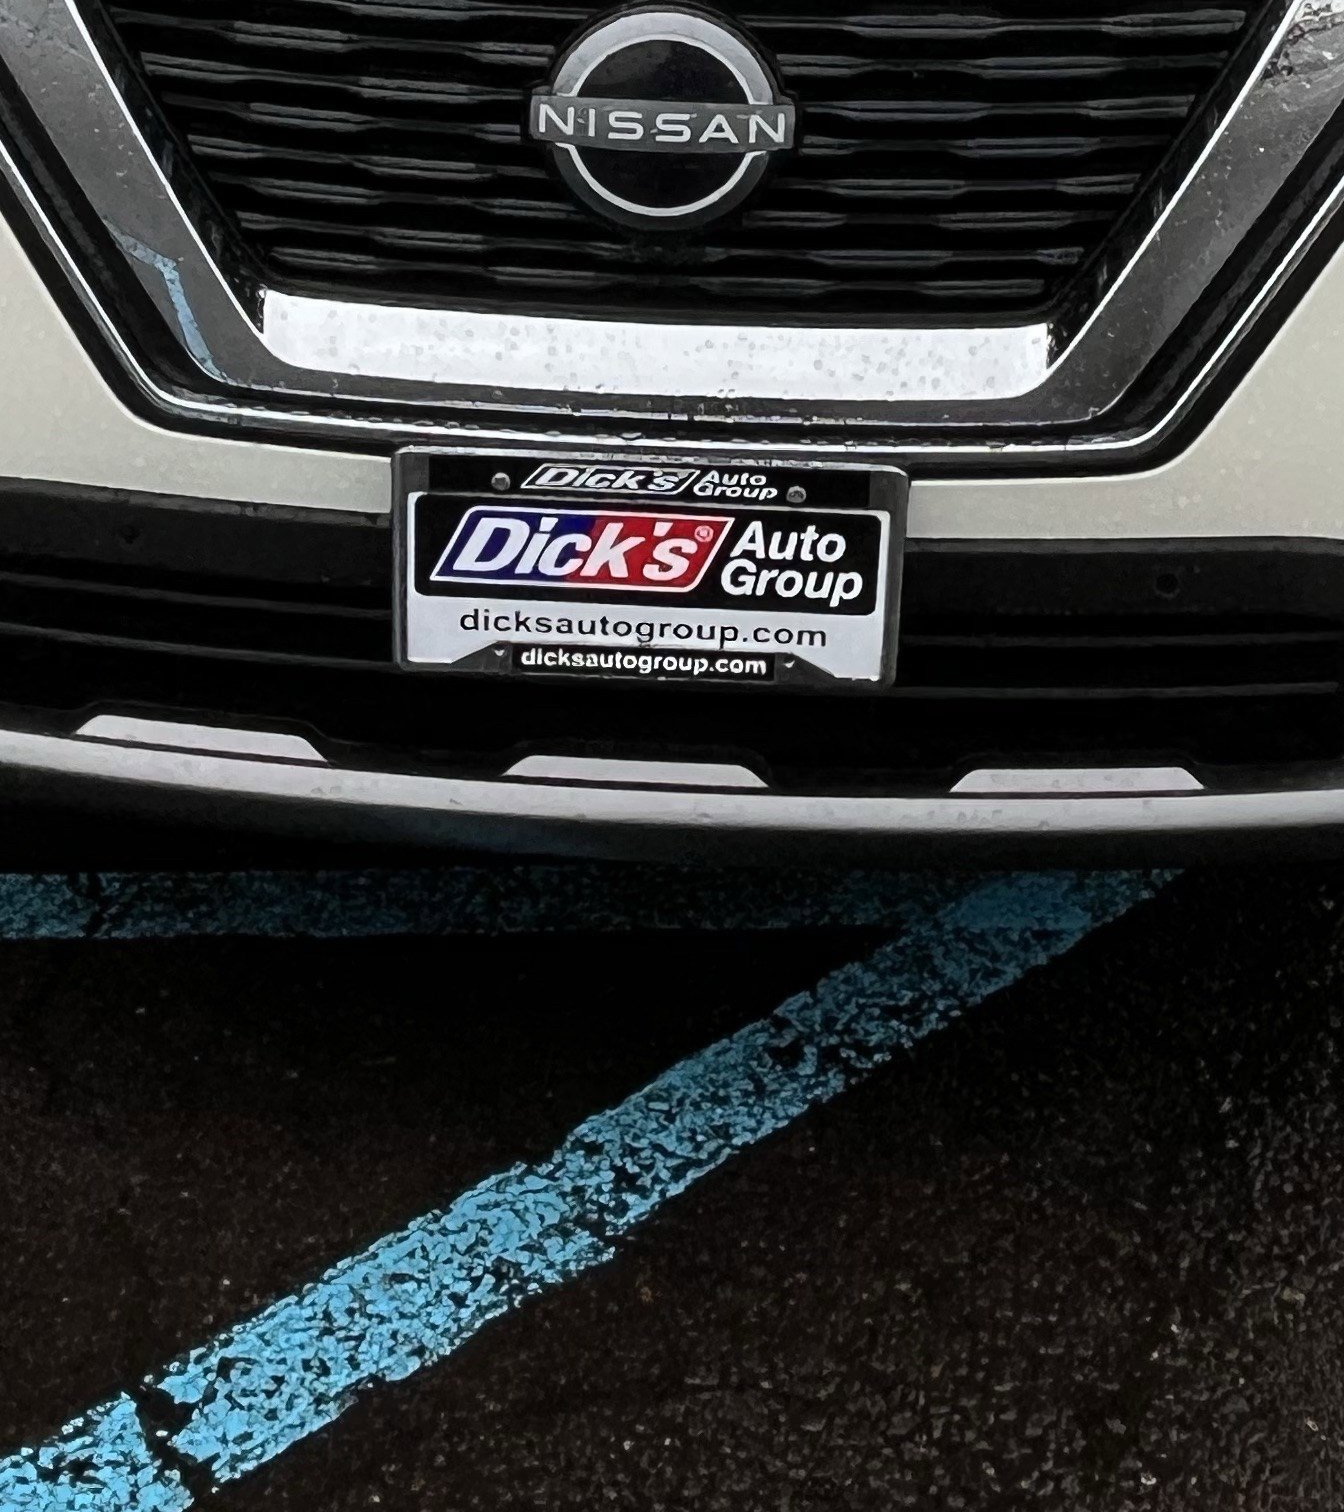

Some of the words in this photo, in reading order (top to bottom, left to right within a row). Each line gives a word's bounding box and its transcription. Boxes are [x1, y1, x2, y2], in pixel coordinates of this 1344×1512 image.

[538, 103, 786, 144] NISSAN
[692, 482, 778, 501] Group
[700, 469, 768, 486] Auto
[452, 515, 698, 582] Dick's
[729, 520, 847, 563] Auto
[720, 558, 863, 608] Group
[459, 608, 828, 650] dicksautogroup.com
[520, 649, 767, 676] dicksautogroup.com
